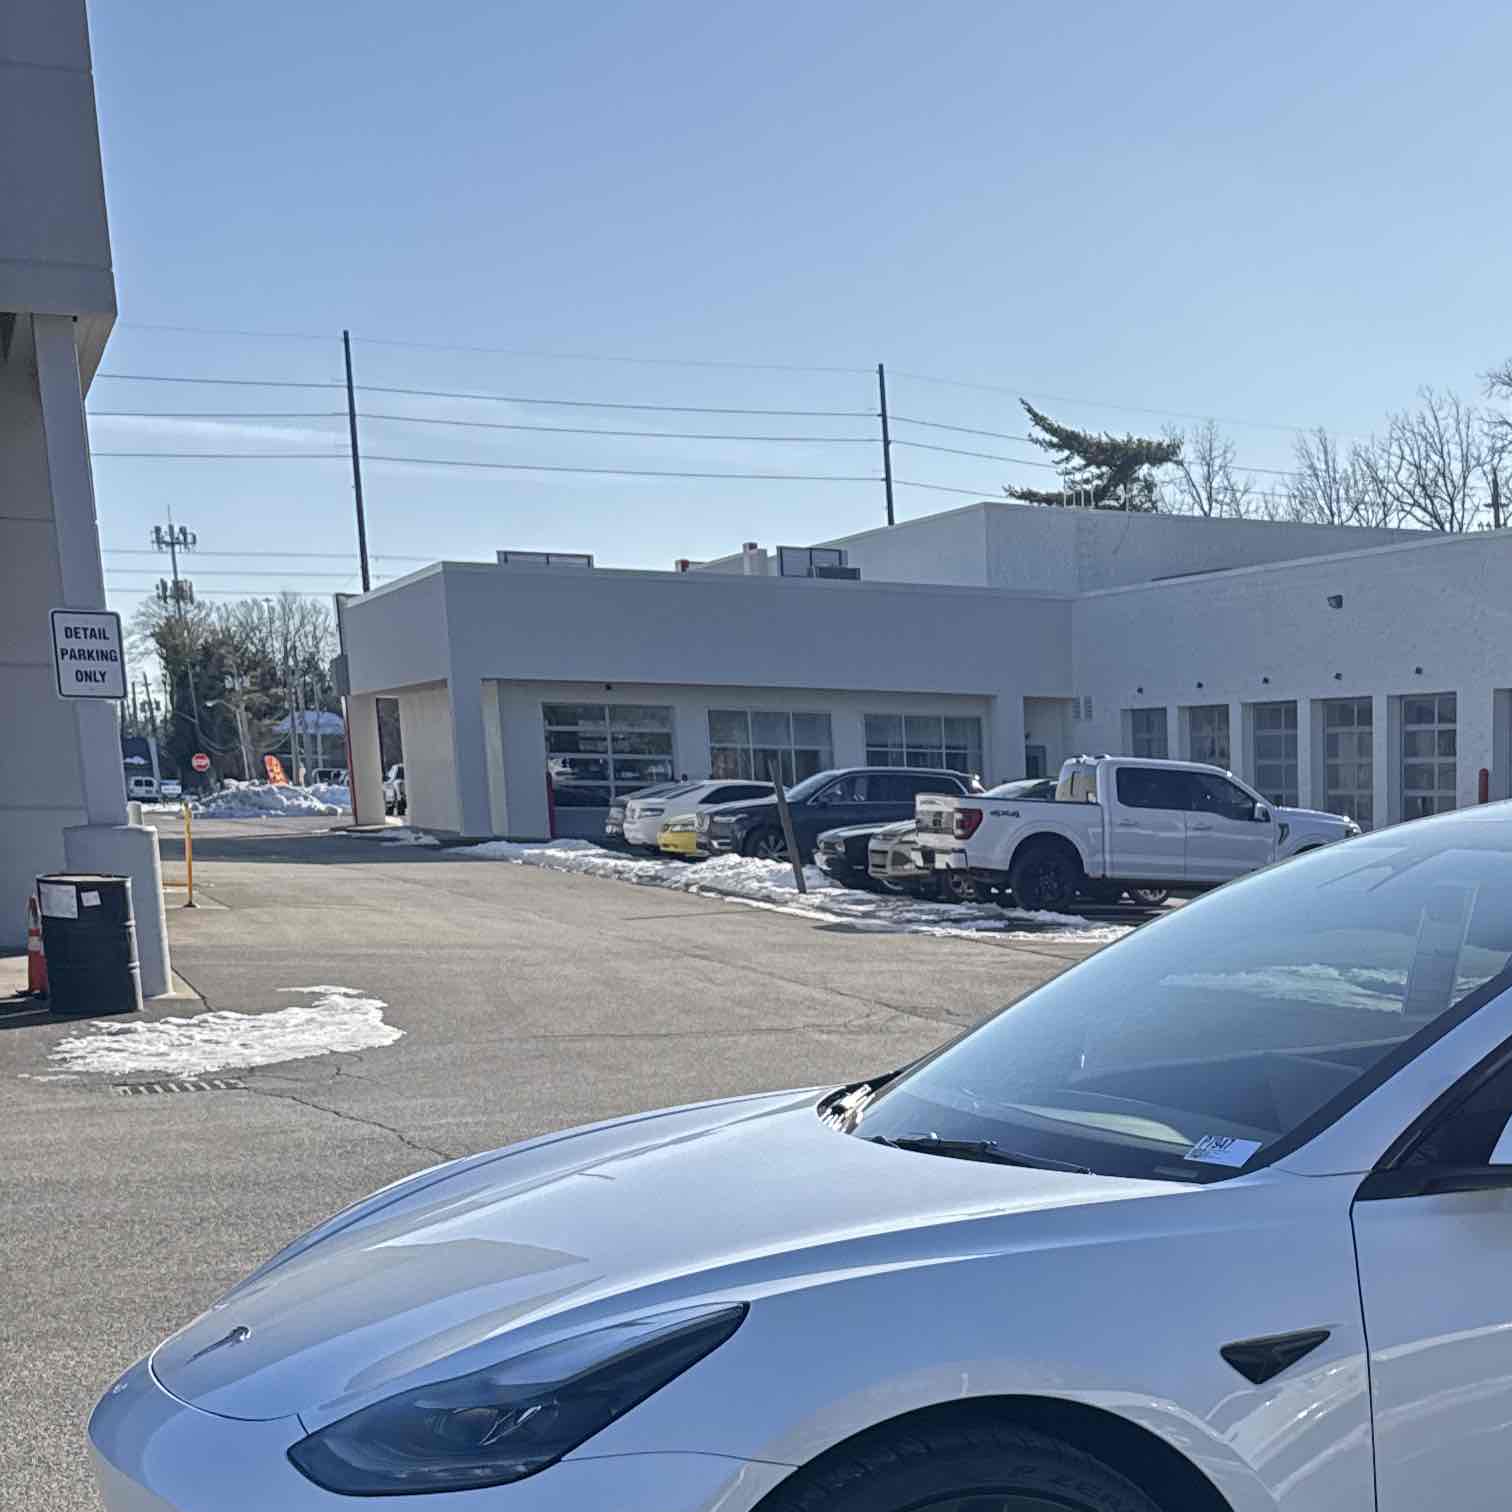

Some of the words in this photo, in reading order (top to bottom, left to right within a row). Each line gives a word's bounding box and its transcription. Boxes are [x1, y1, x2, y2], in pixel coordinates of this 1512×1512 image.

[64, 626, 110, 640] DETAIL
[60, 648, 118, 662] PARKING
[75, 670, 106, 683] ONLY
